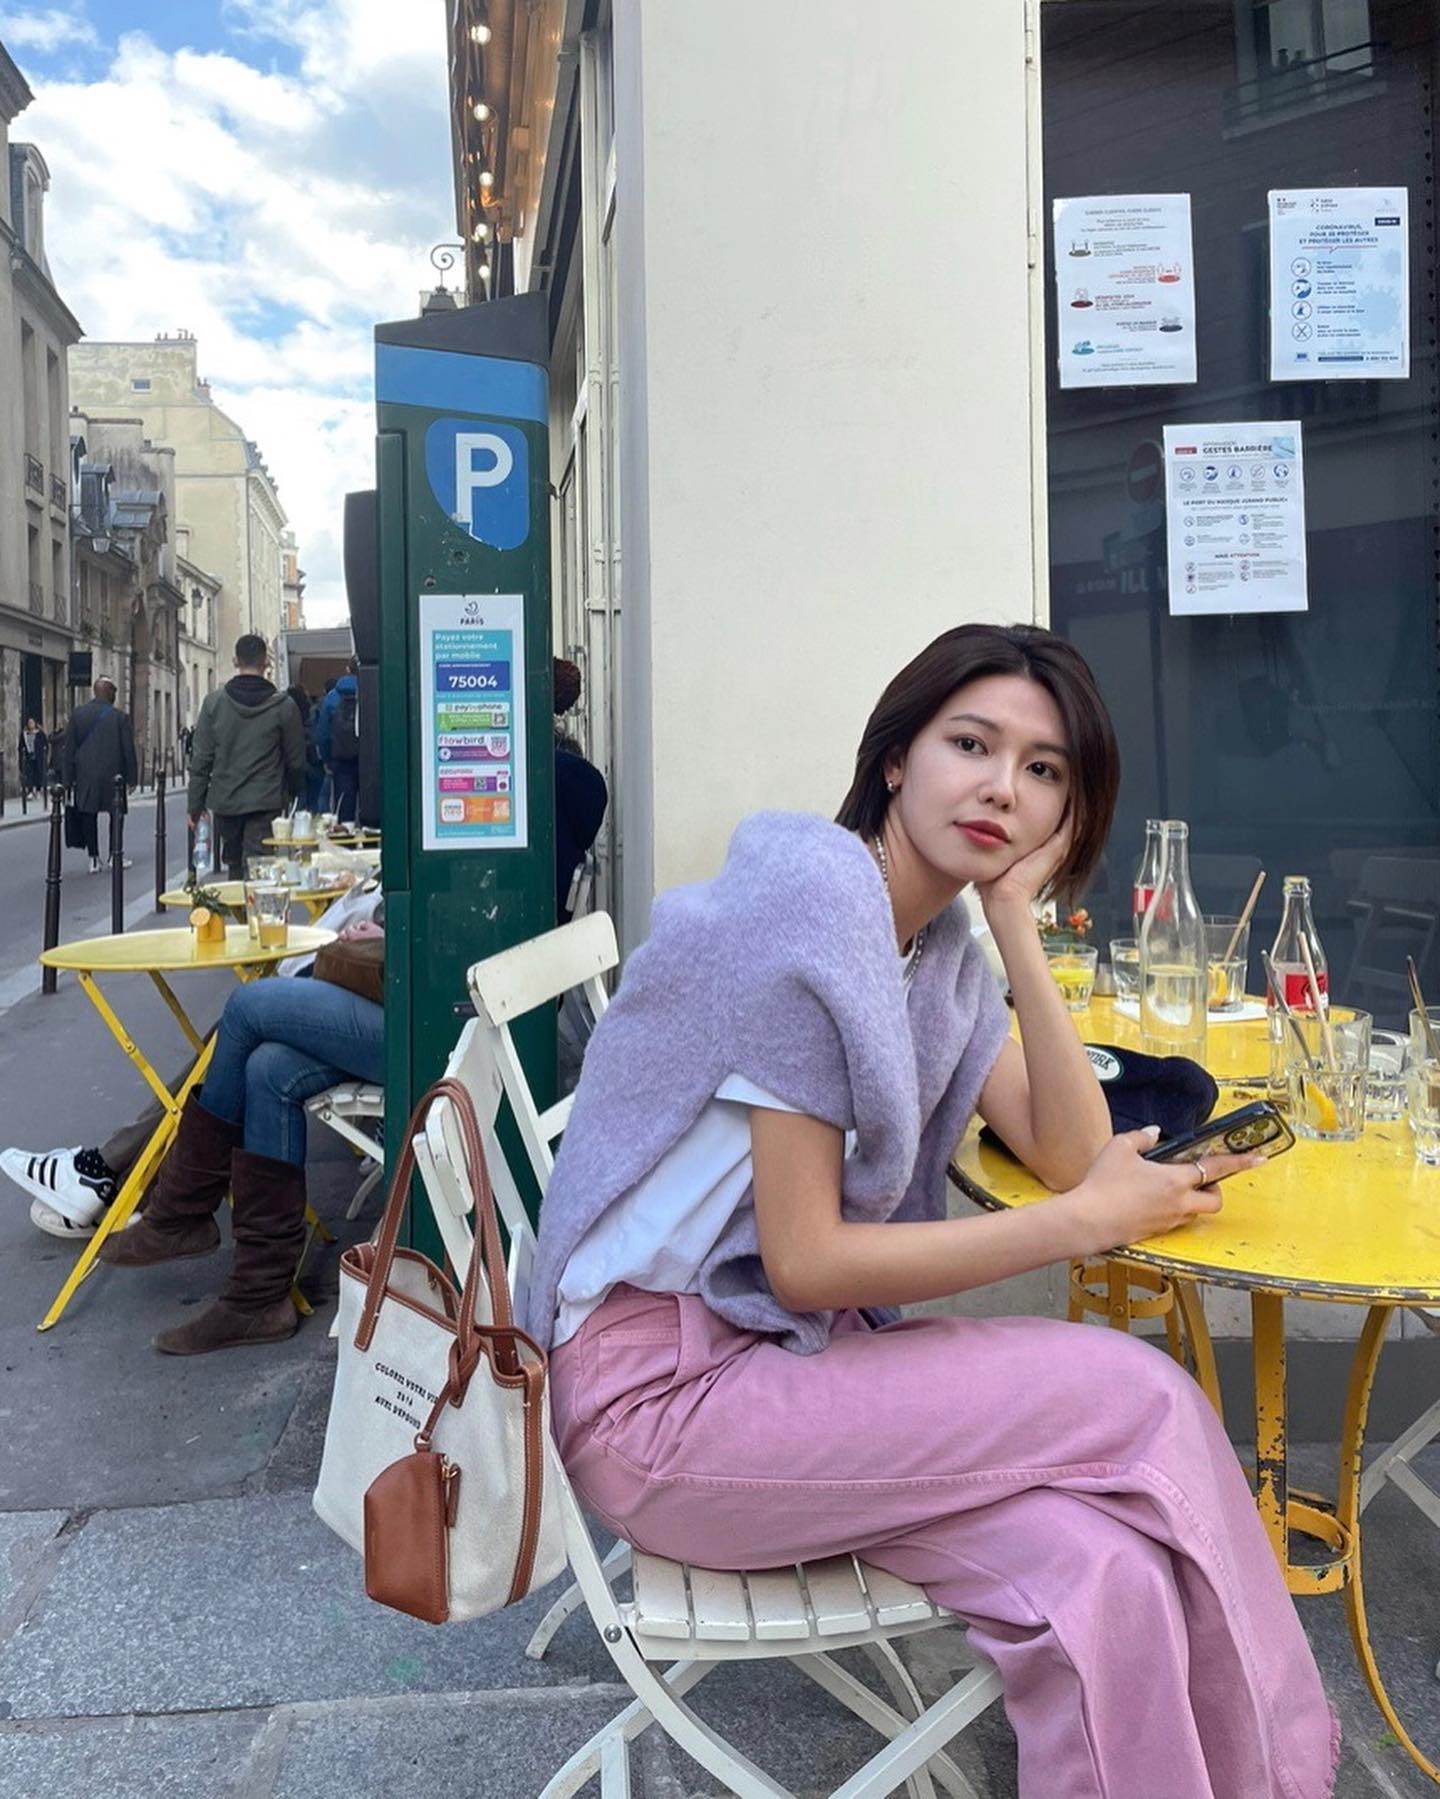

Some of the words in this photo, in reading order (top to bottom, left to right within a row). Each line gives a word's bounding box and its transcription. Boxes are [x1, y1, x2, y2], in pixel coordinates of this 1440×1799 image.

[456, 433, 513, 523] P
[435, 633, 460, 642] Payez
[462, 633, 484, 641] votre
[435, 653, 450, 661] par
[451, 651, 481, 659] mobile
[448, 675, 498, 688] 75004
[439, 736, 485, 744] flowbird
